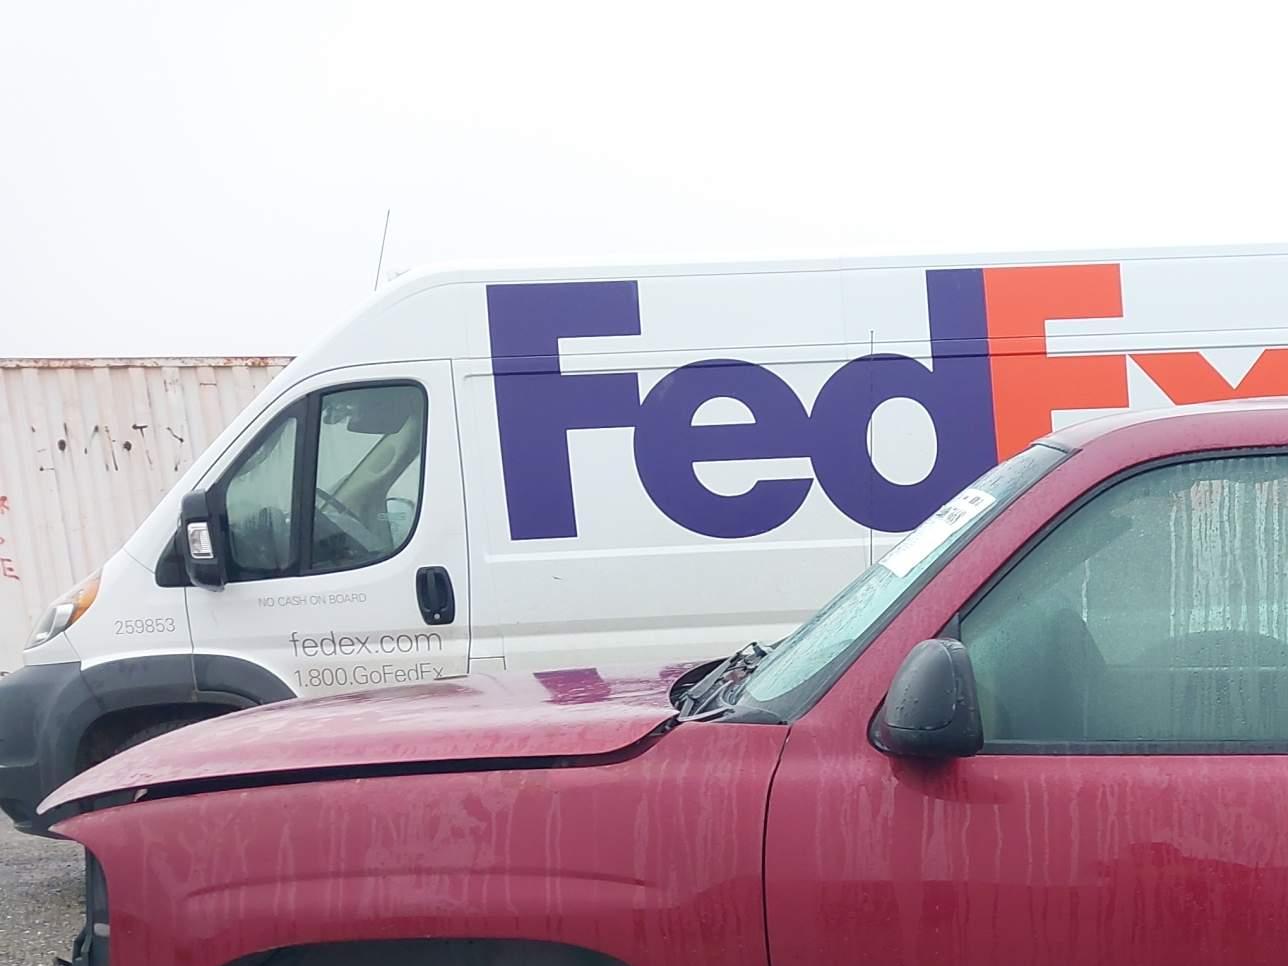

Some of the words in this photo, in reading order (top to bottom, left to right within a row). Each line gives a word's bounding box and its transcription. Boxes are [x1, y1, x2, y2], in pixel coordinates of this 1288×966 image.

[258, 597, 275, 608] NO
[277, 595, 307, 607] CASH
[310, 594, 327, 606] ON
[328, 591, 367, 605] BOARD
[114, 617, 176, 635] 259853
[289, 631, 442, 657] fedex.com
